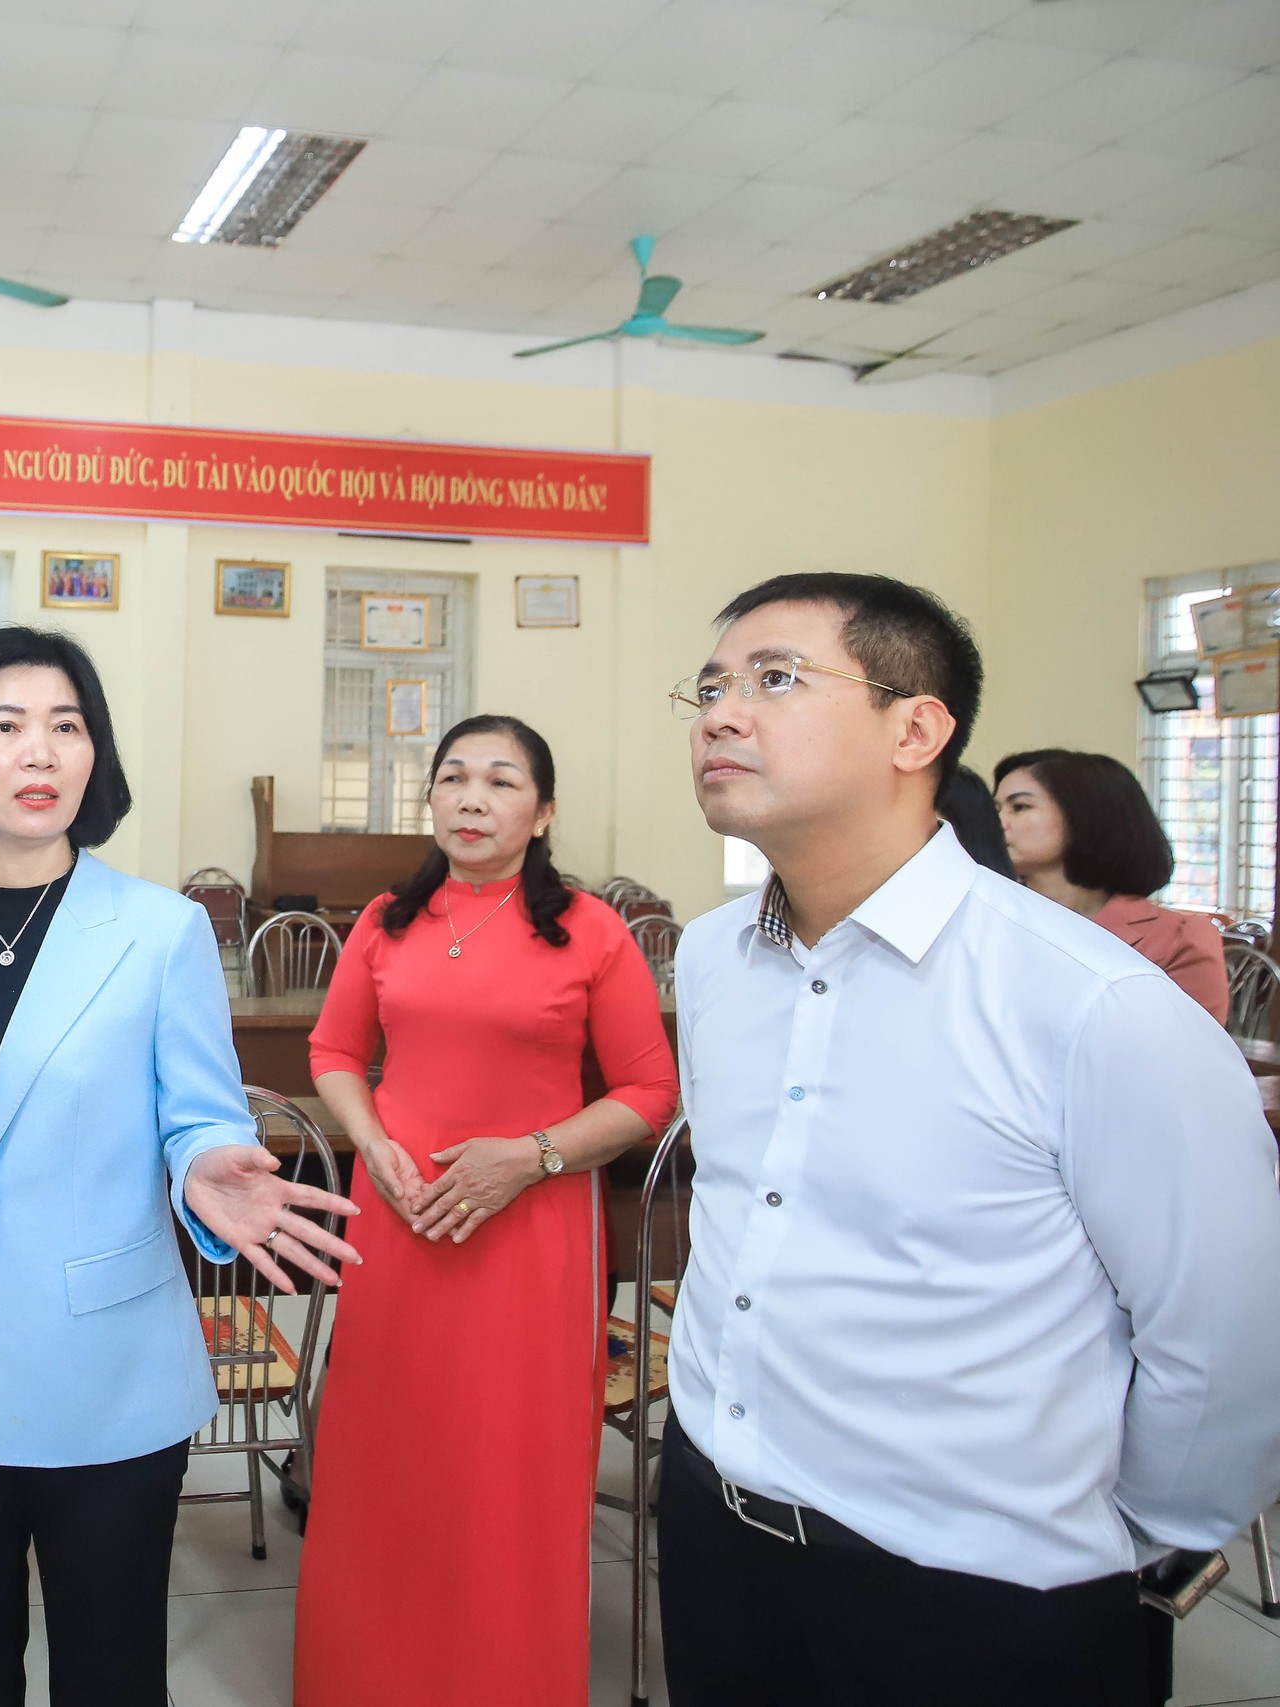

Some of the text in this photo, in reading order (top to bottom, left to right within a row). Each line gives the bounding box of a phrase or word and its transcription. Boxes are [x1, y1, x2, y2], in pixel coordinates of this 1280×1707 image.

[3, 443, 72, 481] NGƯỜI
[76, 447, 105, 484] ĐỦ
[110, 448, 158, 491] ĐỨC,
[162, 452, 190, 489] ĐỦ
[194, 452, 228, 490] TÀI
[233, 456, 275, 494] VÀO
[279, 459, 336, 501] QUỐC
[340, 466, 375, 506] HỘI
[380, 464, 406, 500] VÀ
[411, 470, 445, 510] HỘI
[450, 468, 503, 507] ĐỒNG
